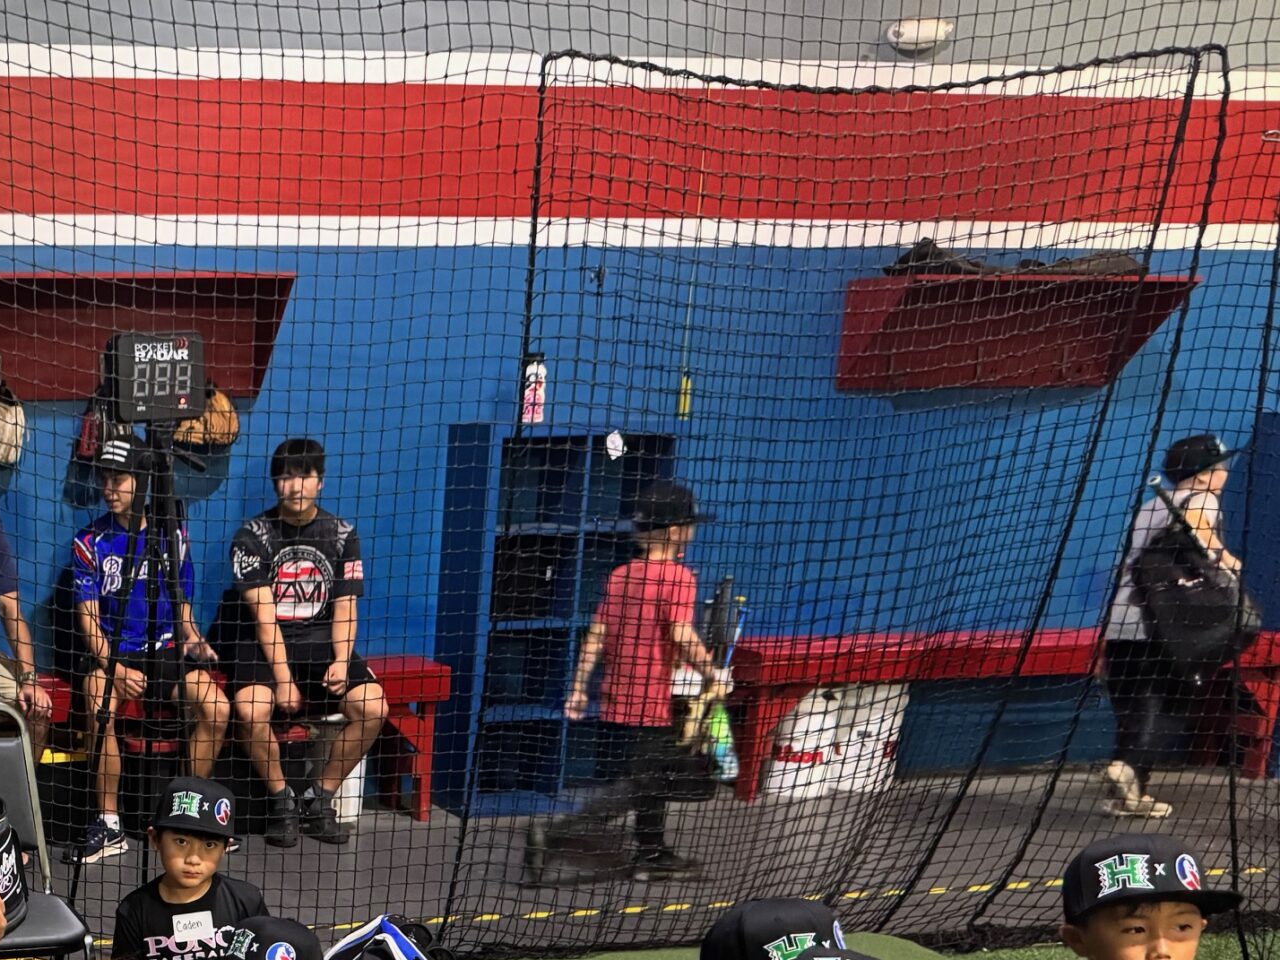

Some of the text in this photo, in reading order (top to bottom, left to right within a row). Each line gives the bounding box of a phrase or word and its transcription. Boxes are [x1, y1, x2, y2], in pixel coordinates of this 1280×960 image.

[134, 342, 173, 353] POCKET
[134, 349, 189, 362] RADAR
[170, 791, 203, 819] H
[1094, 853, 1155, 898] H
[175, 920, 203, 933] Caden
[226, 928, 256, 960] H
